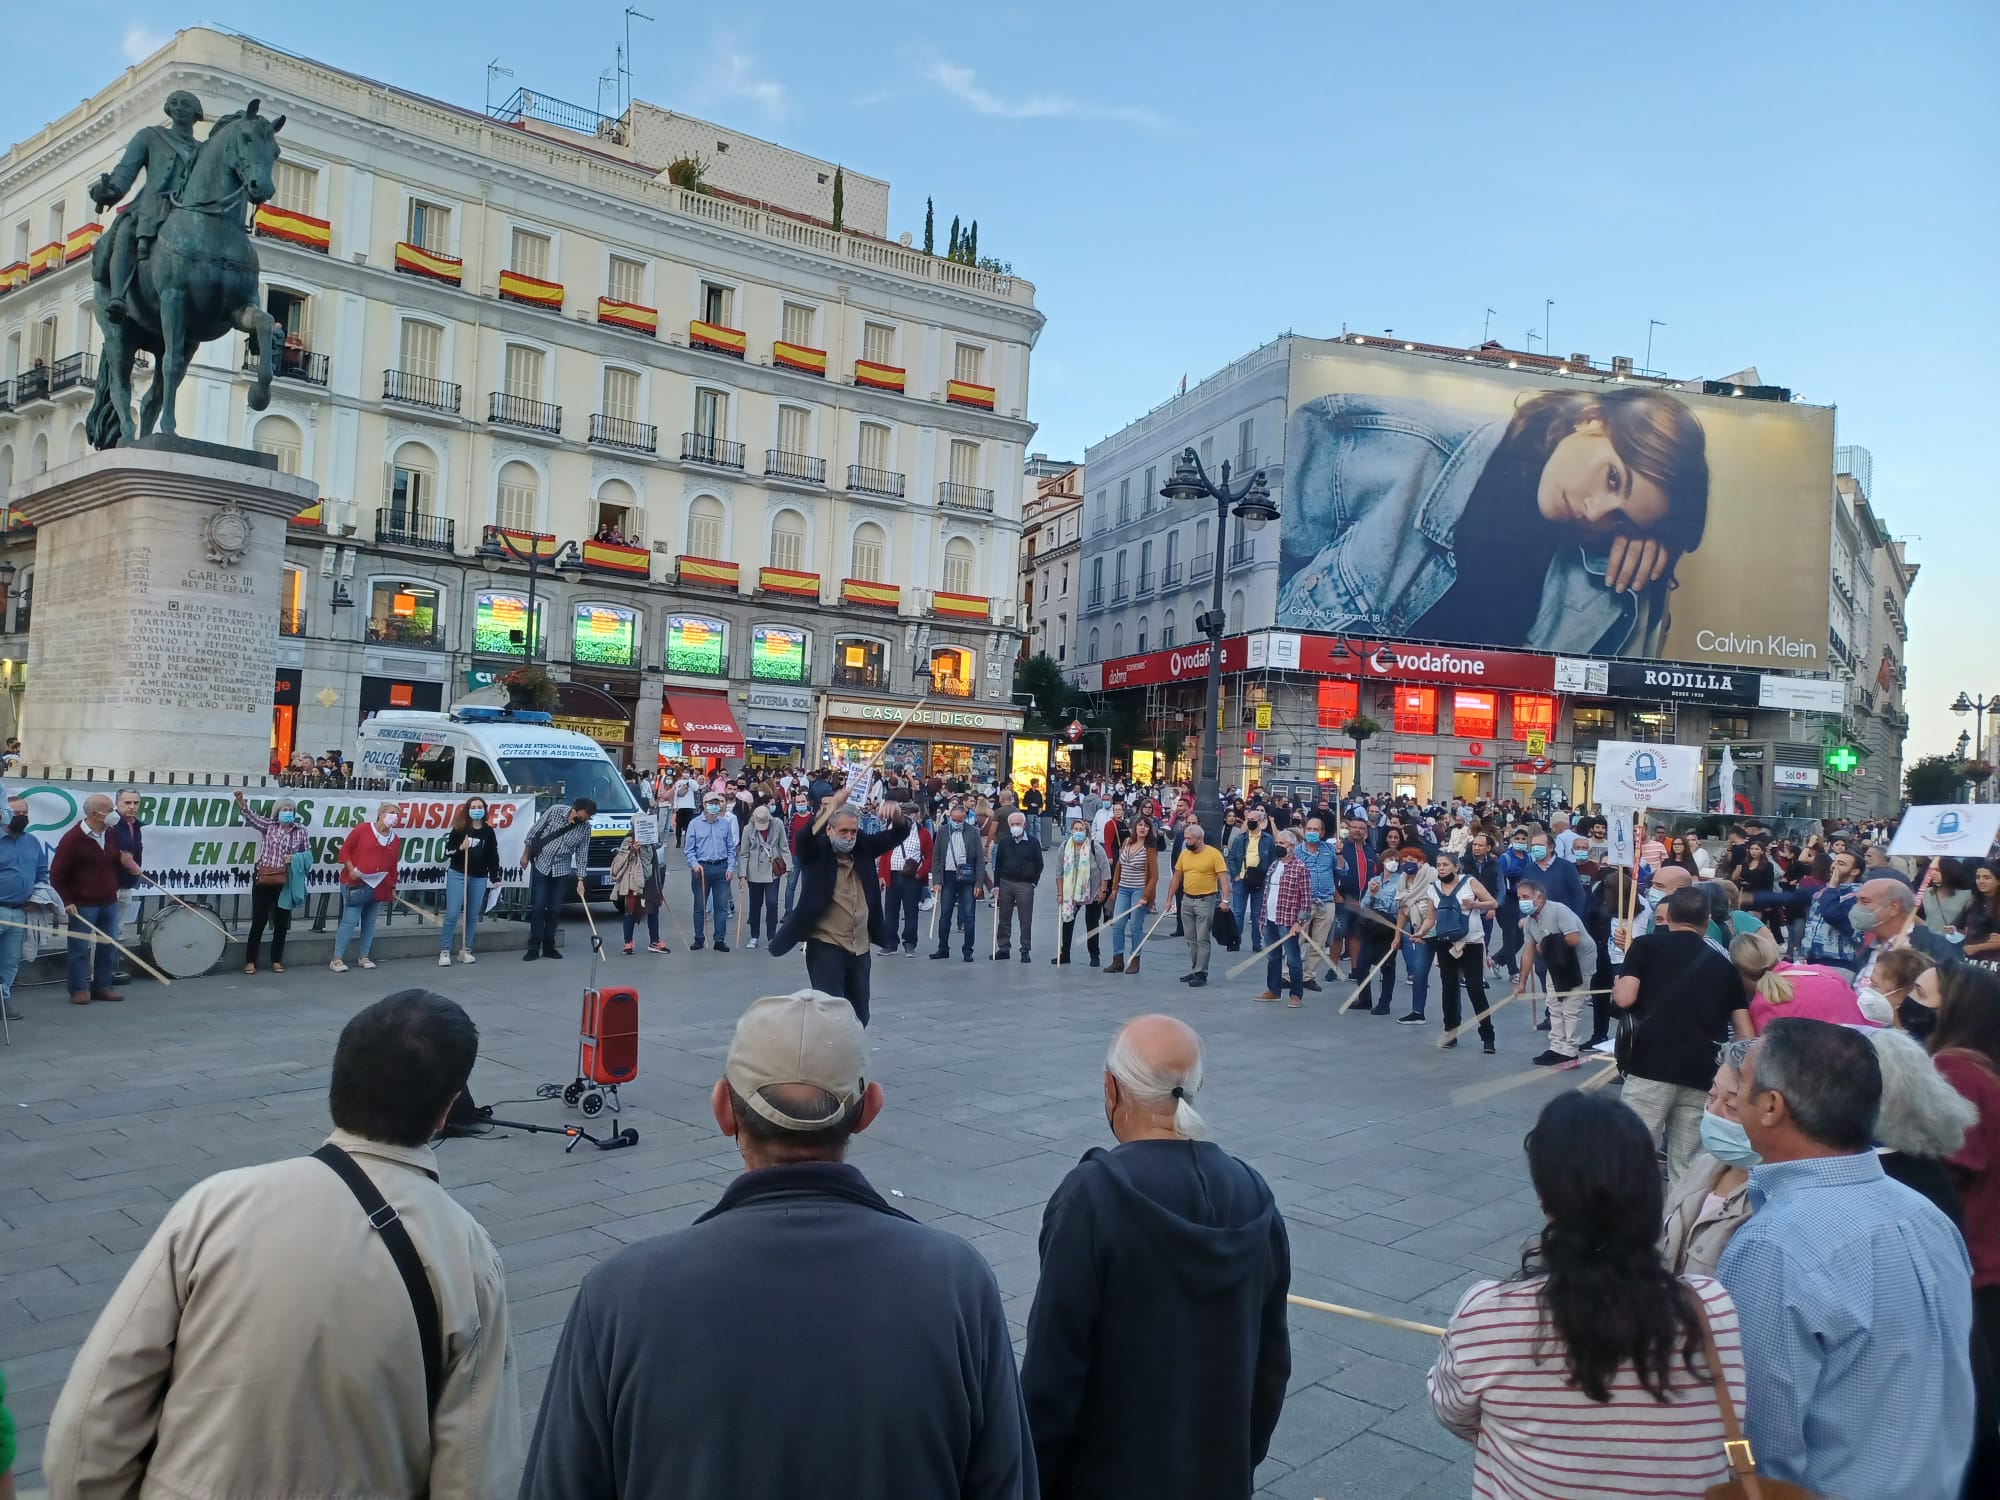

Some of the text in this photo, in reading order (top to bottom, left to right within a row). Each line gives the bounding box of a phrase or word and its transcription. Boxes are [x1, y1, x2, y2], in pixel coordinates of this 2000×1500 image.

[188, 569, 253, 587] CARLOS III
[181, 579, 255, 596] REY DE ESPAÑA
[212, 607, 224, 615] DE
[1290, 606, 1312, 616] Calle
[1313, 609, 1325, 618] de
[1372, 614, 1380, 623] 18
[145, 618, 192, 629] ARTISTAS
[206, 615, 256, 628] FERNANDO
[1696, 630, 1817, 659] Calvin Klein
[168, 655, 227, 668] MERCANCIAS
[1181, 647, 1228, 670] vodafe
[1396, 652, 1485, 675] vodafone
[186, 665, 236, 677] COMERCIO
[1644, 670, 1733, 691] RODILLA
[792, 697, 810, 709] SOL
[862, 706, 903, 721] CASA
[912, 710, 932, 723] DE
[940, 712, 985, 727] DIEGO
[566, 724, 603, 737] TICKETS
[550, 750, 601, 758] ASSISTANCE
[701, 746, 736, 754] CHANGE
[137, 796, 517, 830] BLINDEMS LAS ENSIES
[188, 841, 223, 865] EN
[226, 841, 257, 865] LA
